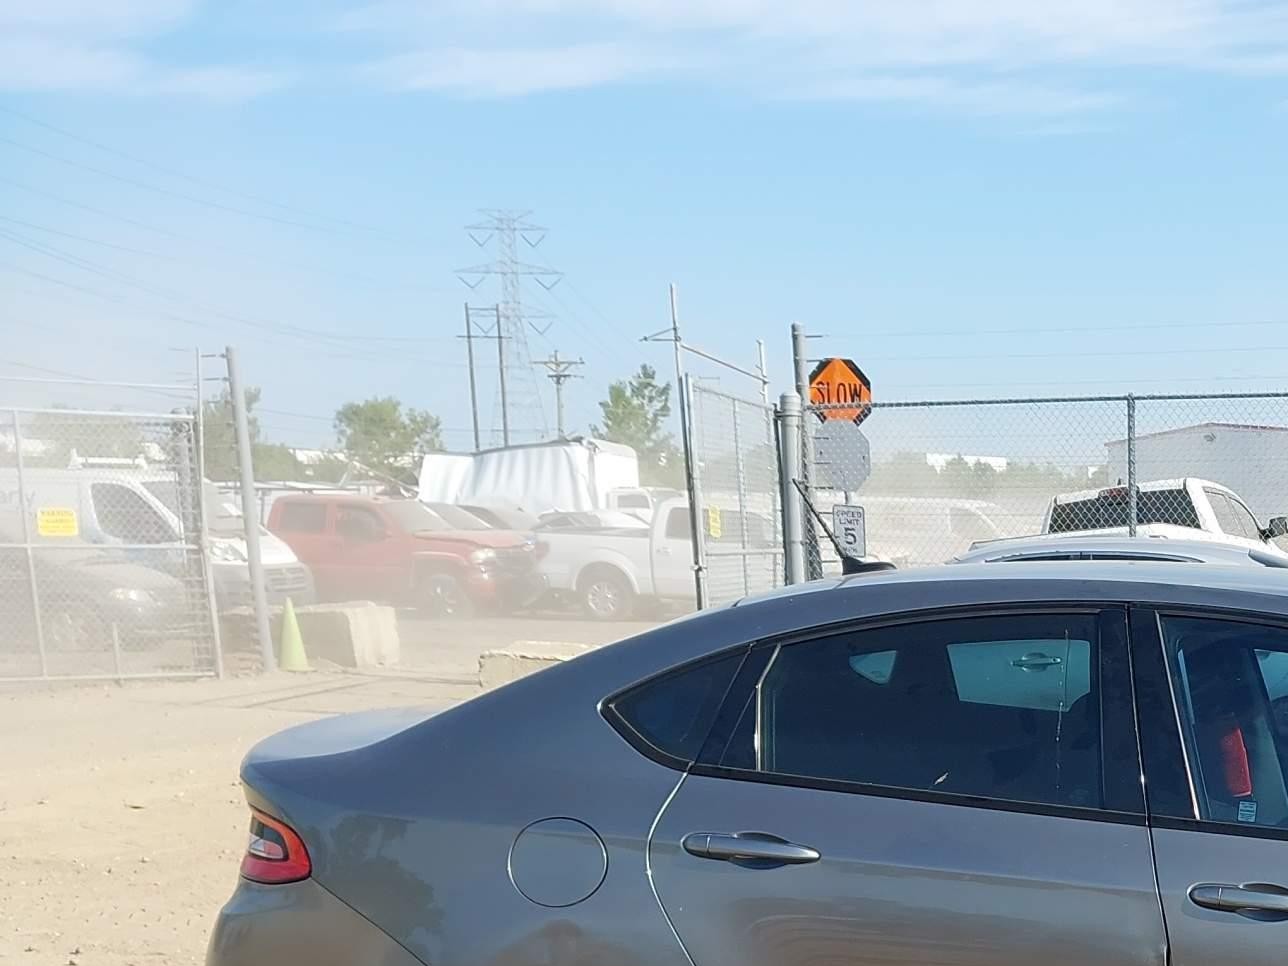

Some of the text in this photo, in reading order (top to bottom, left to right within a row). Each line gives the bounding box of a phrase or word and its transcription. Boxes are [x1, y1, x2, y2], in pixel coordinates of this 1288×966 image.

[814, 381, 862, 404] SLOW
[836, 510, 862, 518] SPEED
[839, 518, 860, 526] LIMIT
[844, 526, 857, 545] 5
